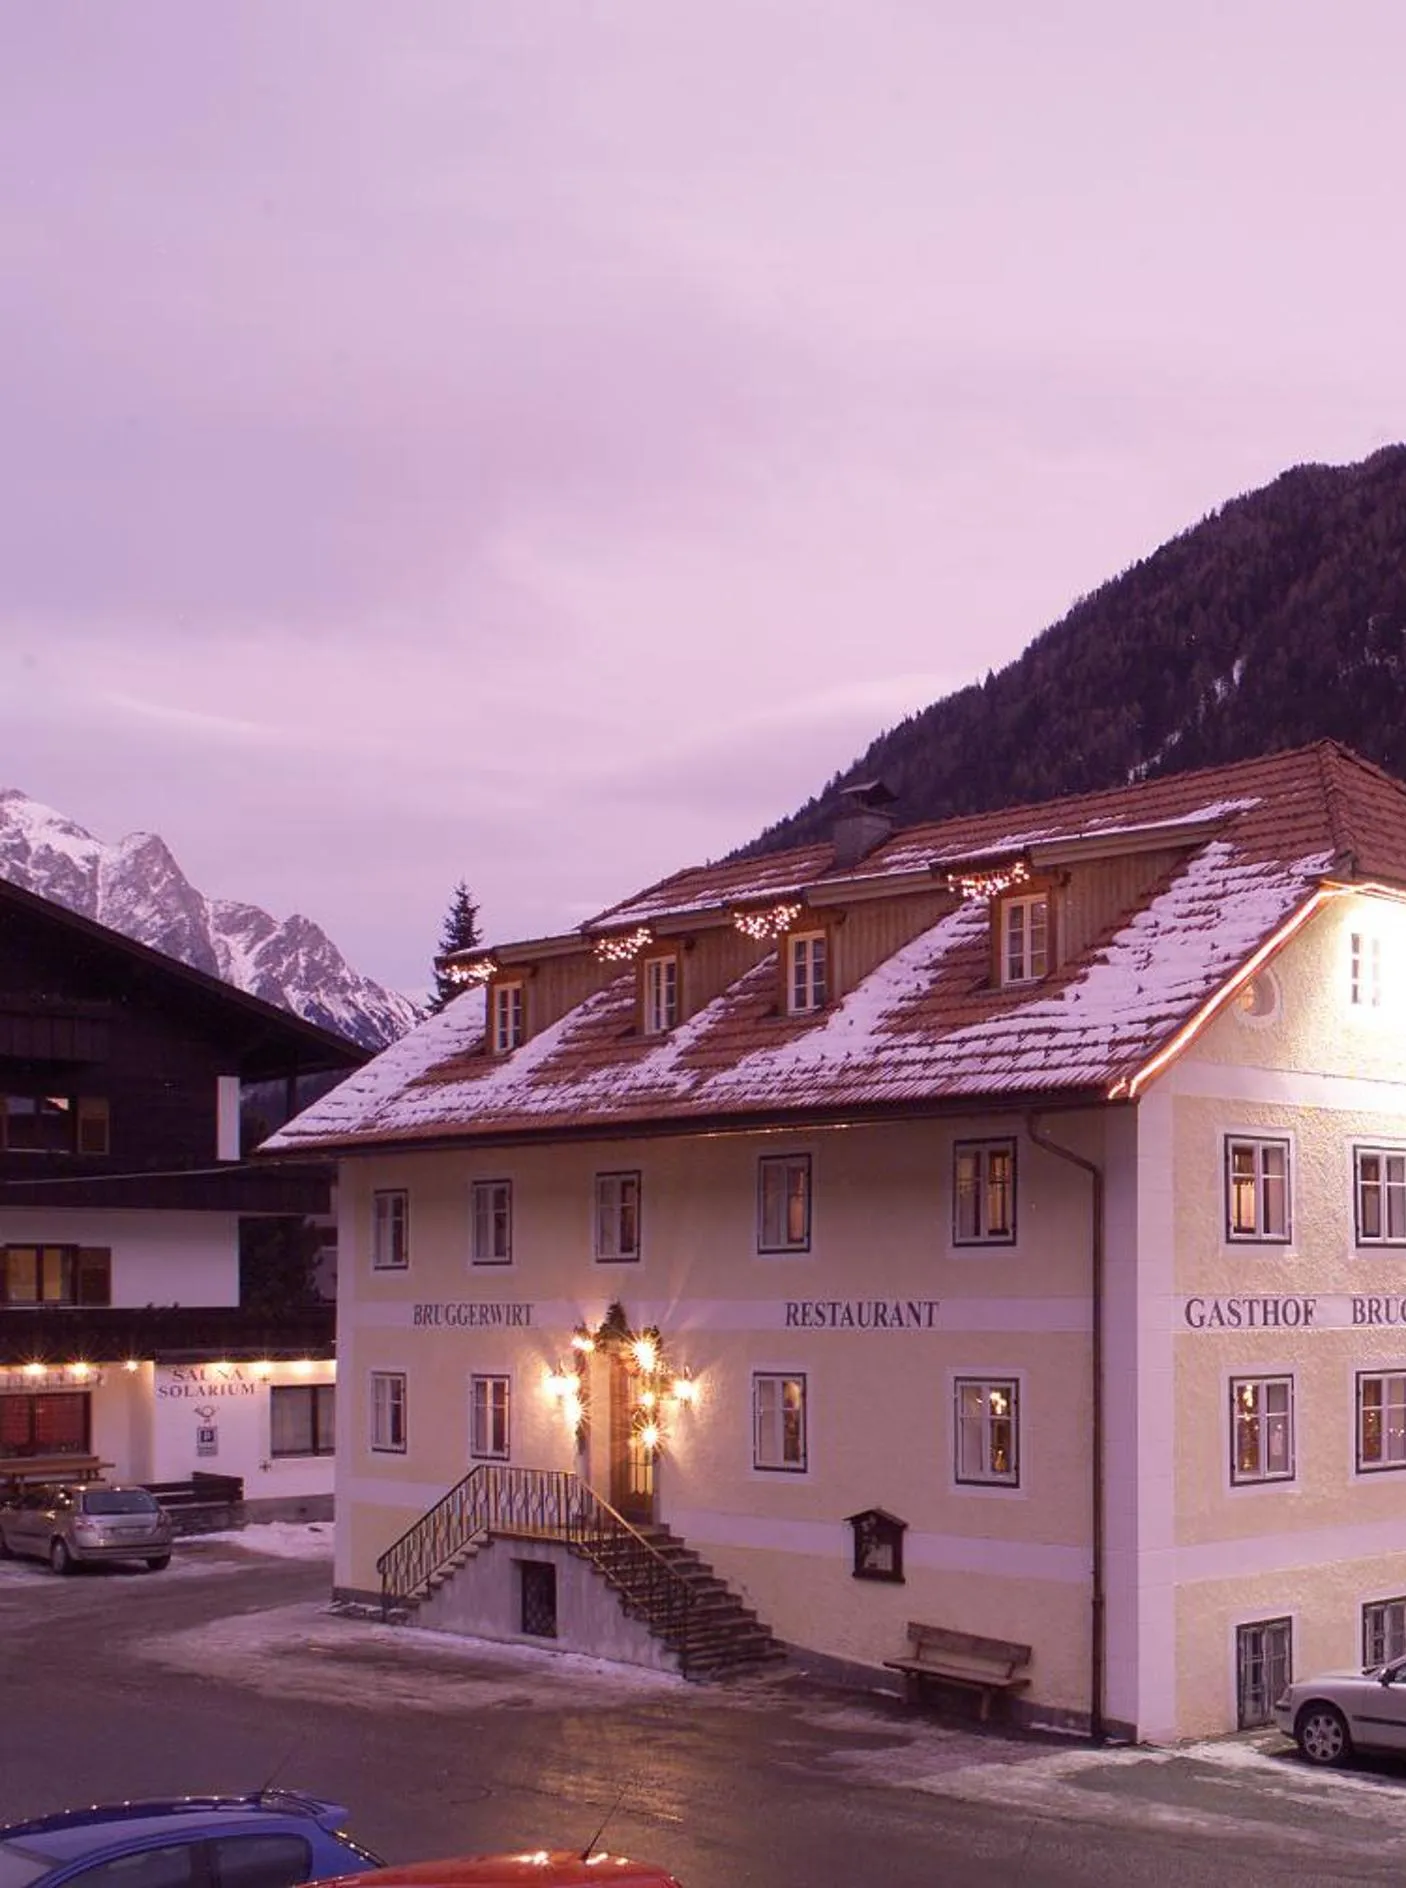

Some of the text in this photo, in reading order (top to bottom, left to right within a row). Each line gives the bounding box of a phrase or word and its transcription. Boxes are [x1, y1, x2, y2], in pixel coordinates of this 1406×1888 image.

[413, 1302, 536, 1326] BRUGGERWIRT
[784, 1302, 939, 1328] RESTAURANT
[1184, 1297, 1317, 1328] GASTHOF
[158, 1383, 256, 1398] SOLARIUM
